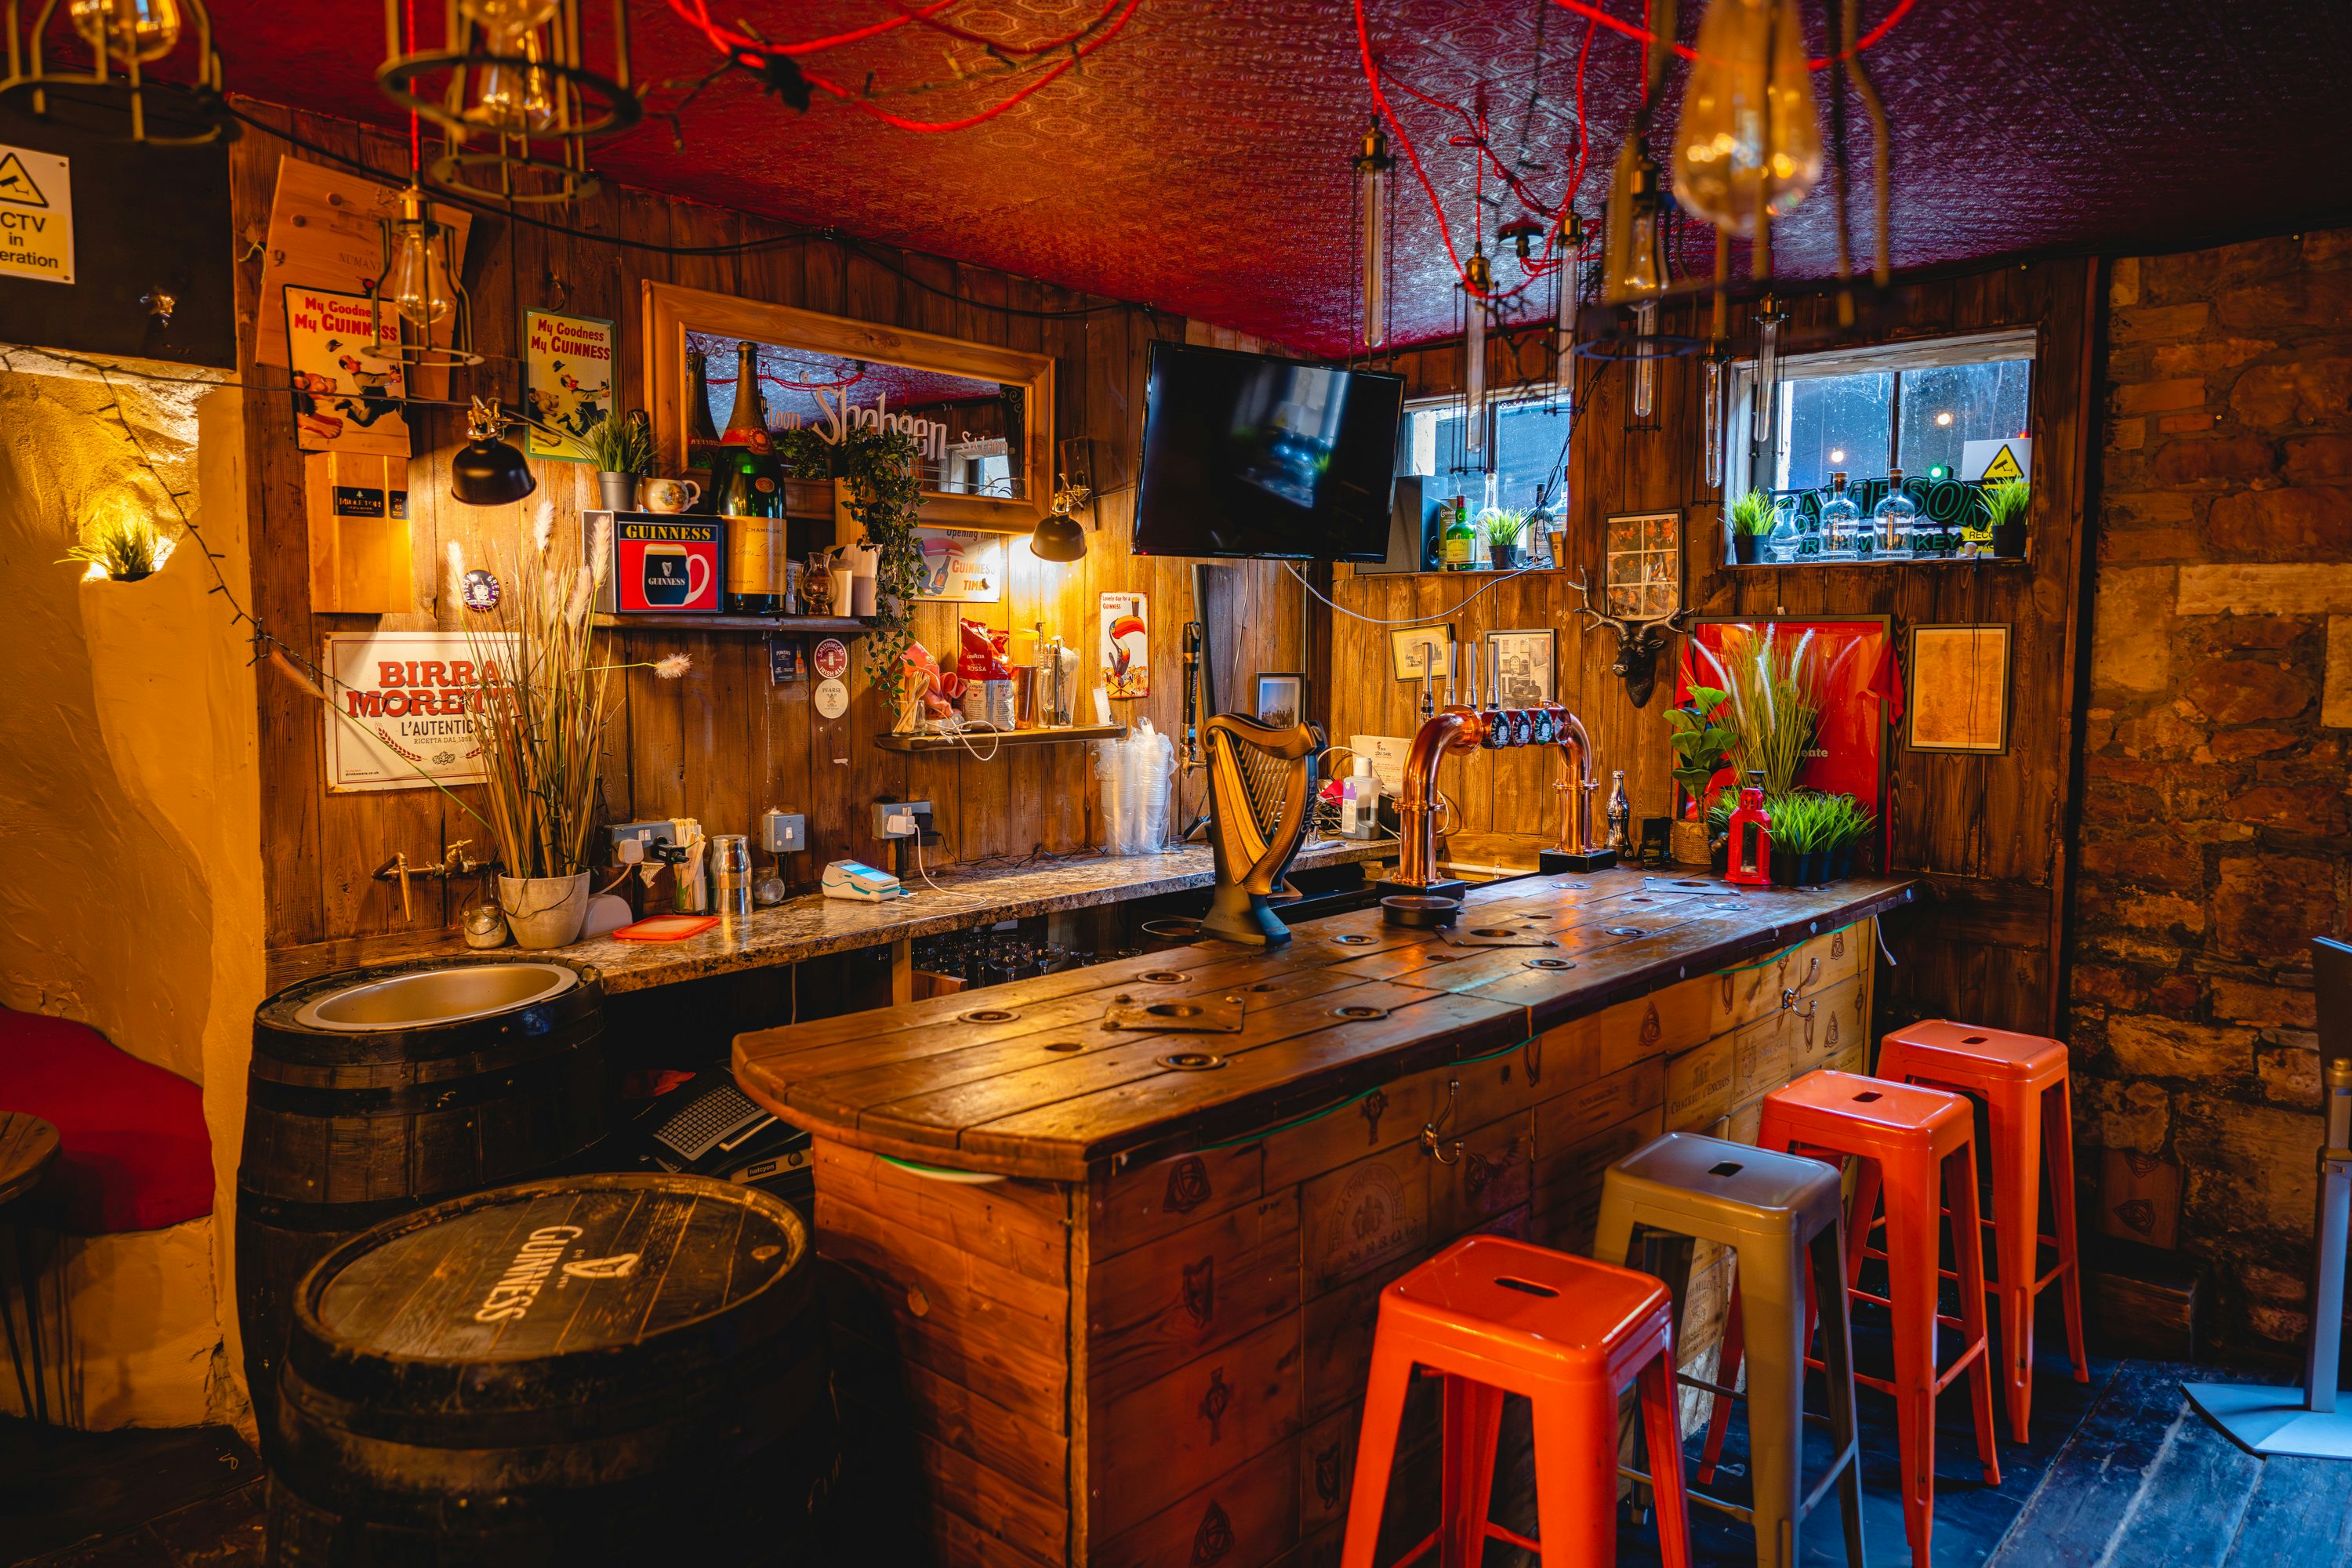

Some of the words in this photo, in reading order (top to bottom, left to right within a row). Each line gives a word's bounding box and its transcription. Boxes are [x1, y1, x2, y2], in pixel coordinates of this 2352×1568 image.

[9, 232, 24, 247] in
[305, 296, 324, 314] My
[328, 300, 383, 320] Goodnes
[294, 314, 317, 333] My
[321, 314, 398, 342] GUINNSS
[537, 318, 553, 336] My
[556, 321, 604, 342] Goodness
[531, 336, 547, 354] My
[551, 336, 611, 361] GUINNESS
[766, 402, 801, 431] loon
[626, 524, 711, 541] GUINNESS
[952, 560, 996, 575] GUINNESS
[648, 577, 686, 586] GUINNESS
[964, 579, 983, 591] TIME
[378, 660, 503, 688] BIRRA
[819, 666, 834, 677] IRISH
[835, 665, 844, 676] ALE
[401, 719, 477, 737] L'AUTENTIC
[1301, 775, 1316, 833] GUINNESS
[750, 1163, 775, 1174] halcyon
[474, 1225, 584, 1322] GUINNESS
